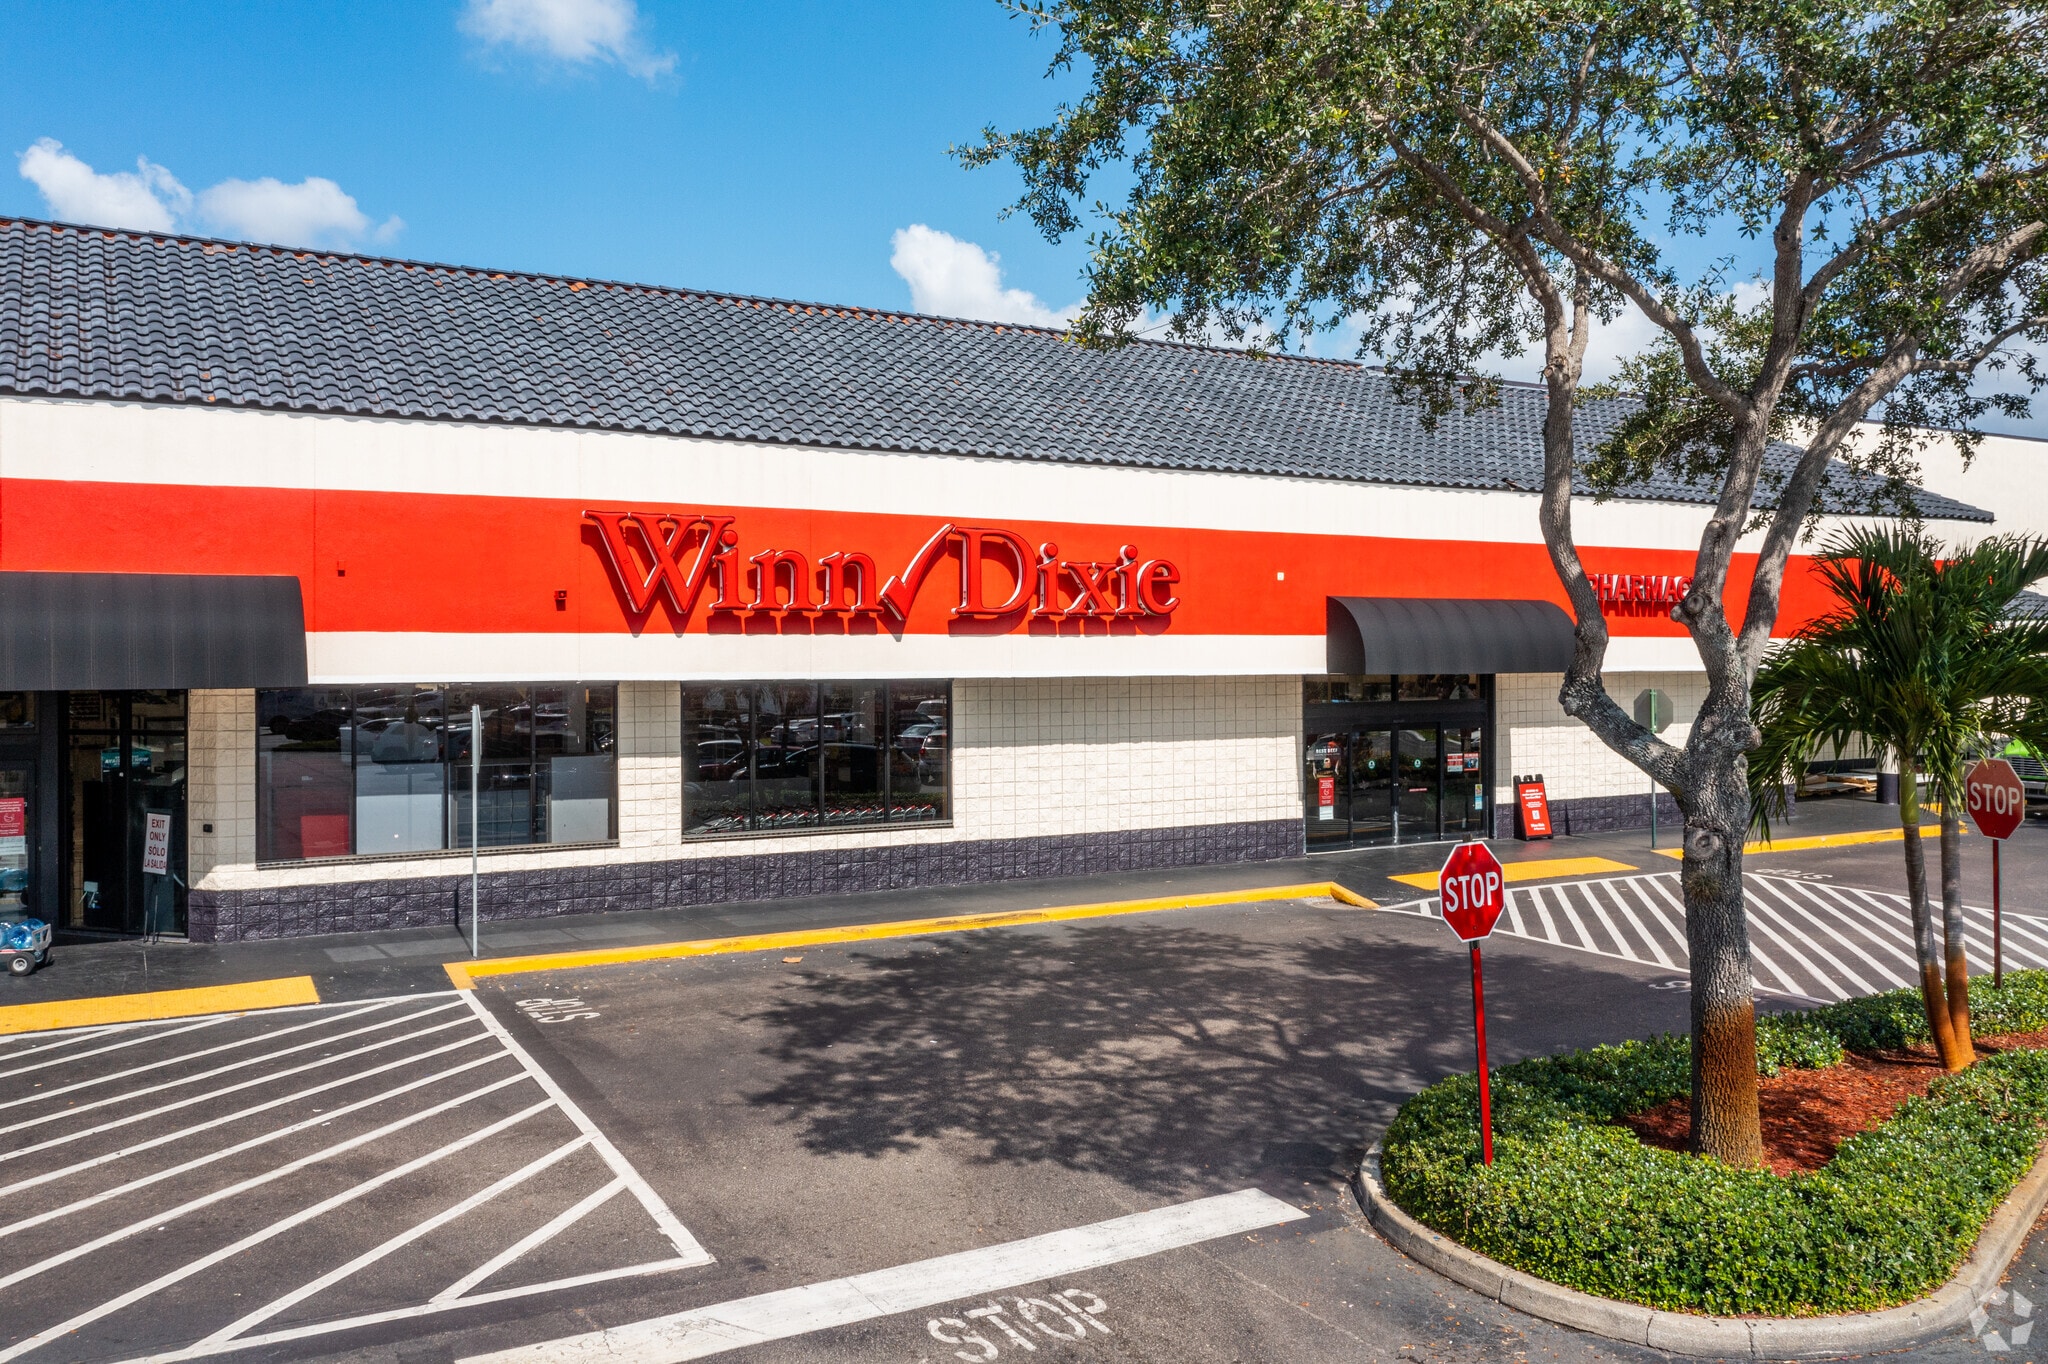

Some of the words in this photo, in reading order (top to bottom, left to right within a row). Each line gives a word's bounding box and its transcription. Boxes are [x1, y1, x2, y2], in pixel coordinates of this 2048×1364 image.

[582, 509, 884, 613] Winn
[951, 526, 1180, 615] Dixie
[1587, 573, 1694, 602] PHARMAC
[1969, 782, 2020, 816] STOP
[149, 831, 166, 841] ONLY
[151, 819, 165, 828] EXIT
[1445, 871, 1500, 912] STOP
[927, 1288, 1107, 1363] STOP
